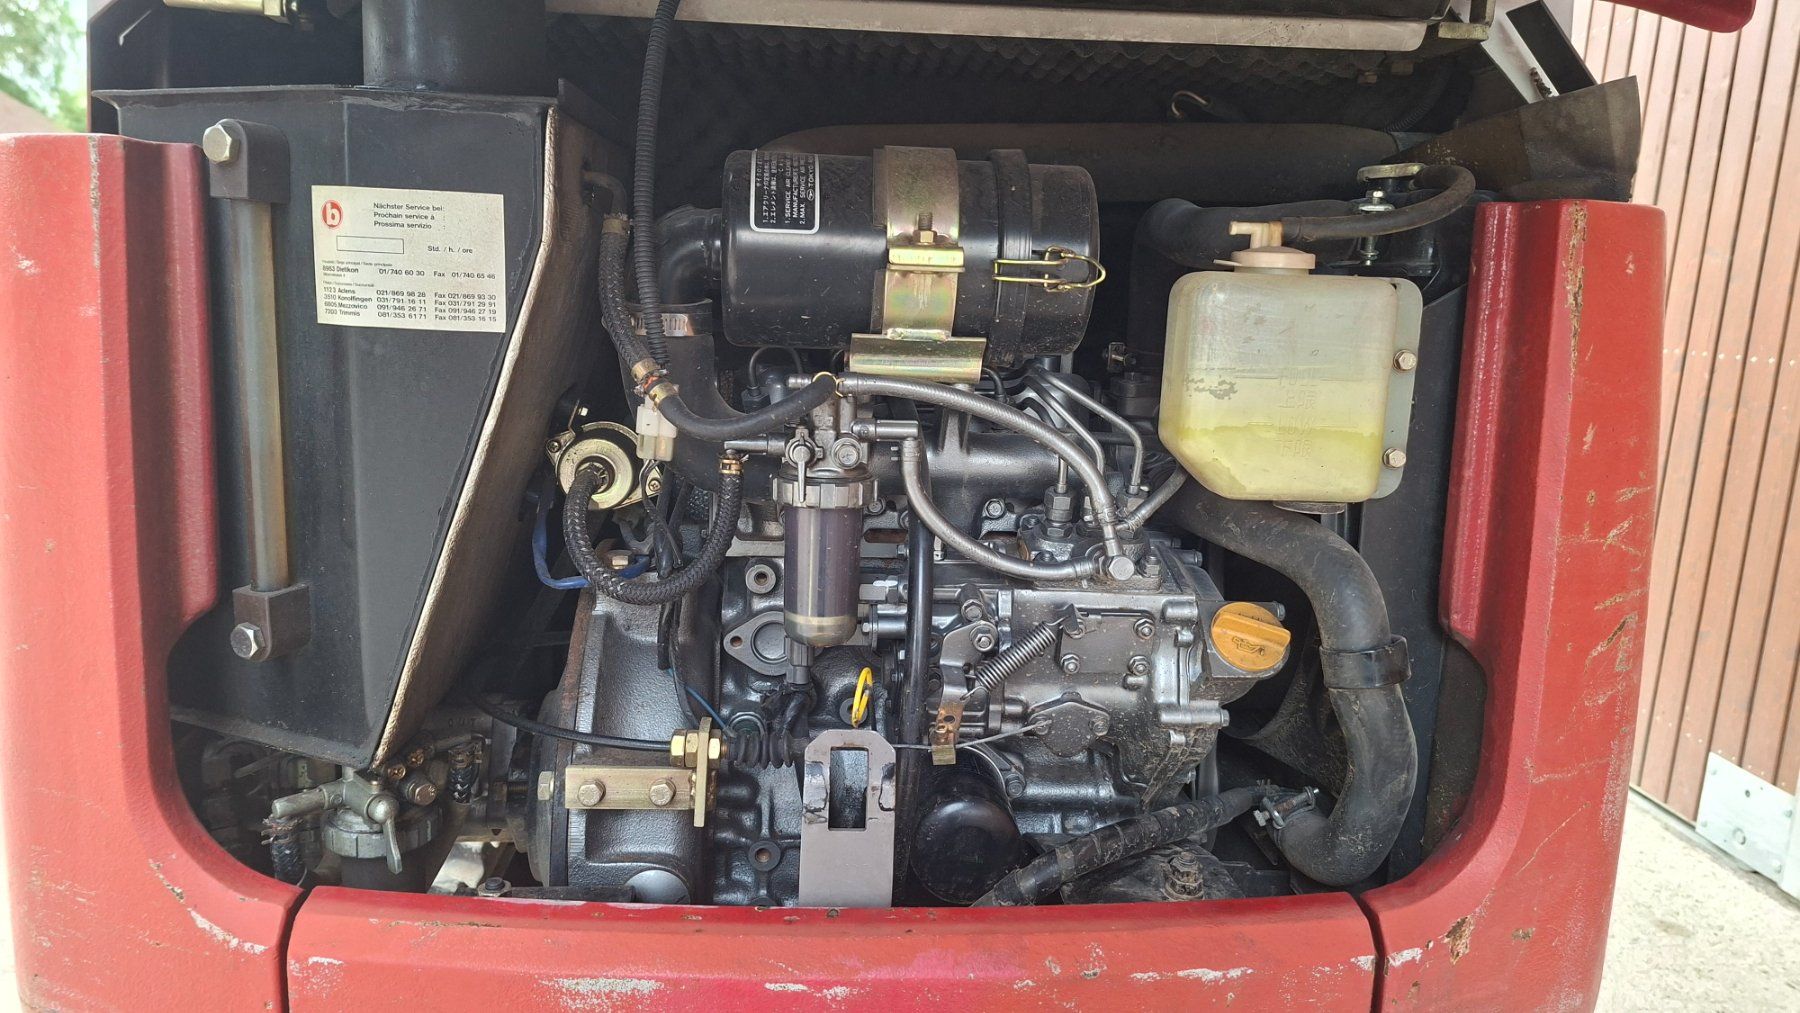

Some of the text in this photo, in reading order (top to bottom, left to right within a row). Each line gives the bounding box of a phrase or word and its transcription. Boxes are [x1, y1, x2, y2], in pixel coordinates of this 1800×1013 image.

[373, 211, 402, 219] Prochain
[373, 220, 404, 228] Prossima
[378, 268, 402, 276] 01/740
[337, 295, 372, 303] Konolfingen
[337, 302, 368, 310] Mezzovico
